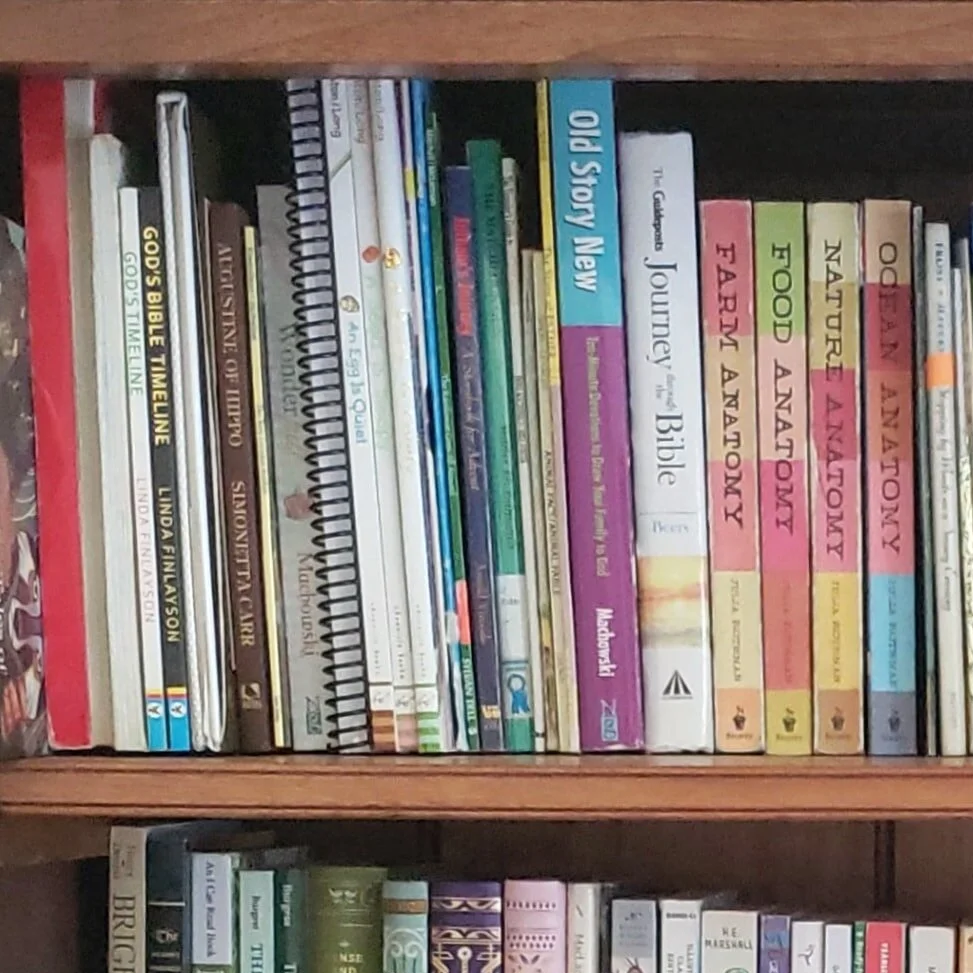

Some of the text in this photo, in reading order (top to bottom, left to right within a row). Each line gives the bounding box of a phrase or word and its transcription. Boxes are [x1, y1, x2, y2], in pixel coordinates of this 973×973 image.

[564, 110, 604, 292] Old Story New
[123, 251, 143, 396] GOD'S TIMELINE
[143, 226, 172, 446] GOD'S BIBLE TIMELINE
[217, 243, 243, 446] AUGUSTINE OF HIPPO
[644, 168, 684, 486] The Guideposts Journey Bible
[716, 244, 743, 529] FARM ANATOMY
[772, 243, 794, 536] FOOD ANATOMY
[824, 239, 845, 561] NATURE ANATOMY
[878, 241, 902, 554] OCEAN ANATOMY
[136, 478, 156, 623] LINDA FINLAYSON
[158, 487, 181, 642] LINDA FINLAYSON
[231, 481, 255, 646] SIMONETTA CARR
[595, 608, 616, 677] Machowski
